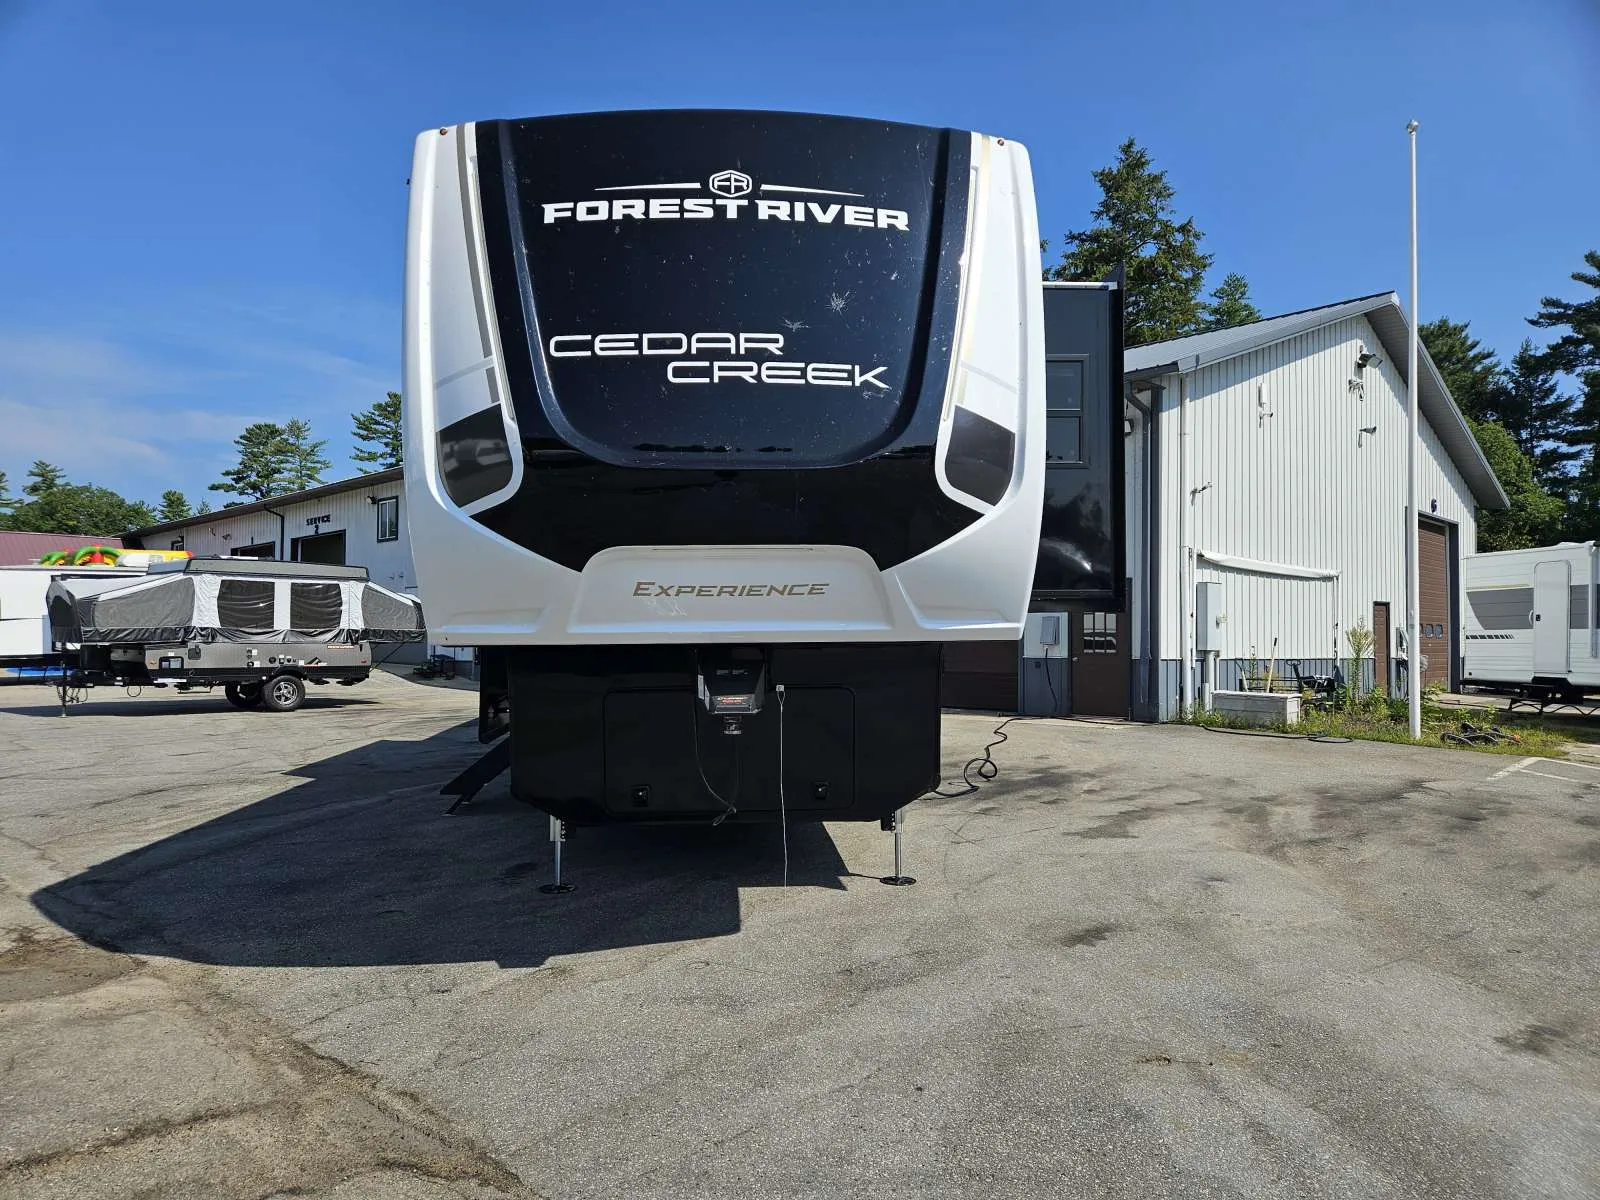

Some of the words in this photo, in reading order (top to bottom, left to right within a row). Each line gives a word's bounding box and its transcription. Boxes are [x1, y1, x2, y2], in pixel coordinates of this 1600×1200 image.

[541, 198, 749, 224] FOREST
[754, 199, 910, 231] RIVER
[549, 332, 785, 358] CEDAR
[666, 361, 892, 389] CREEK
[306, 514, 331, 525] SERVICE
[632, 581, 830, 597] EXPERIENCE
